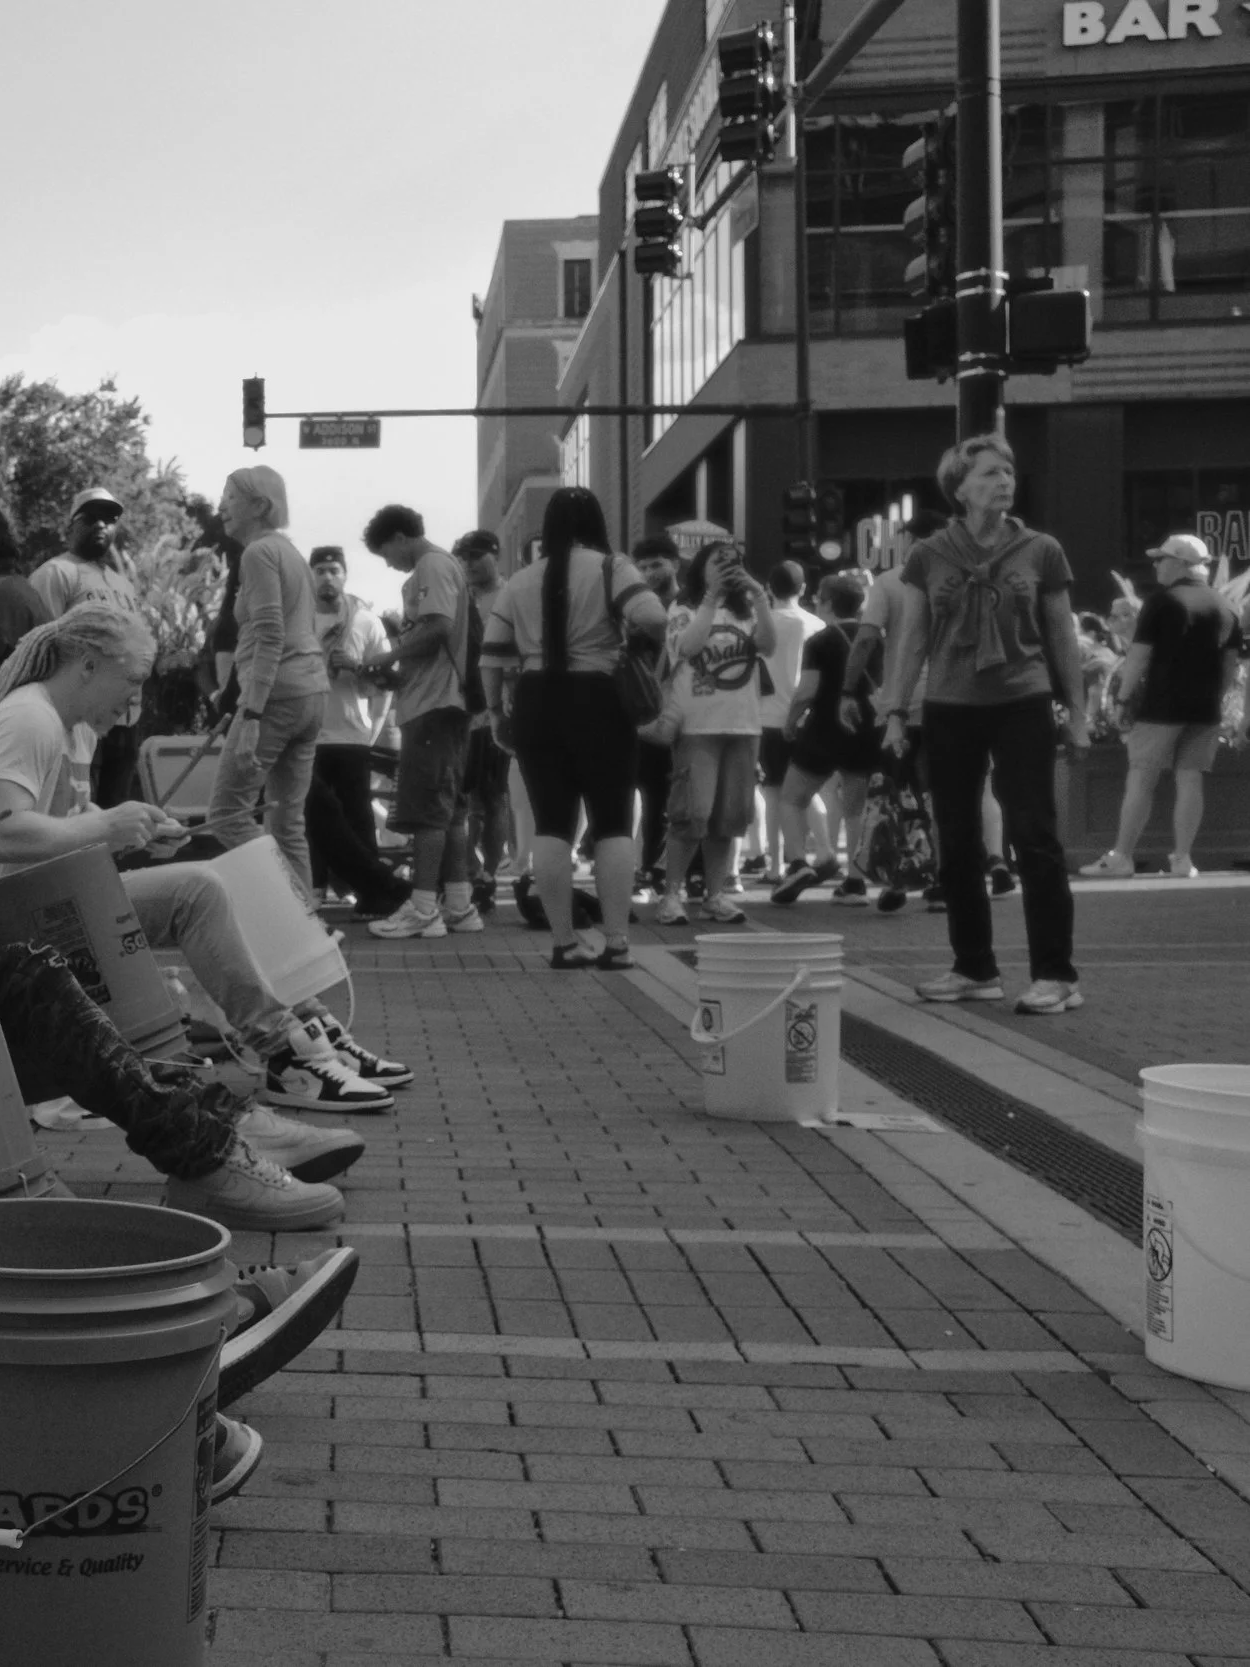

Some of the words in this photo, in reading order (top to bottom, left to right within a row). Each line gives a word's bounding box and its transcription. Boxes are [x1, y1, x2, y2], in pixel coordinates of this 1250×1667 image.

[1063, 0, 1223, 47] BAR
[57, 1558, 73, 1577] &
[79, 1552, 145, 1578] Quality
